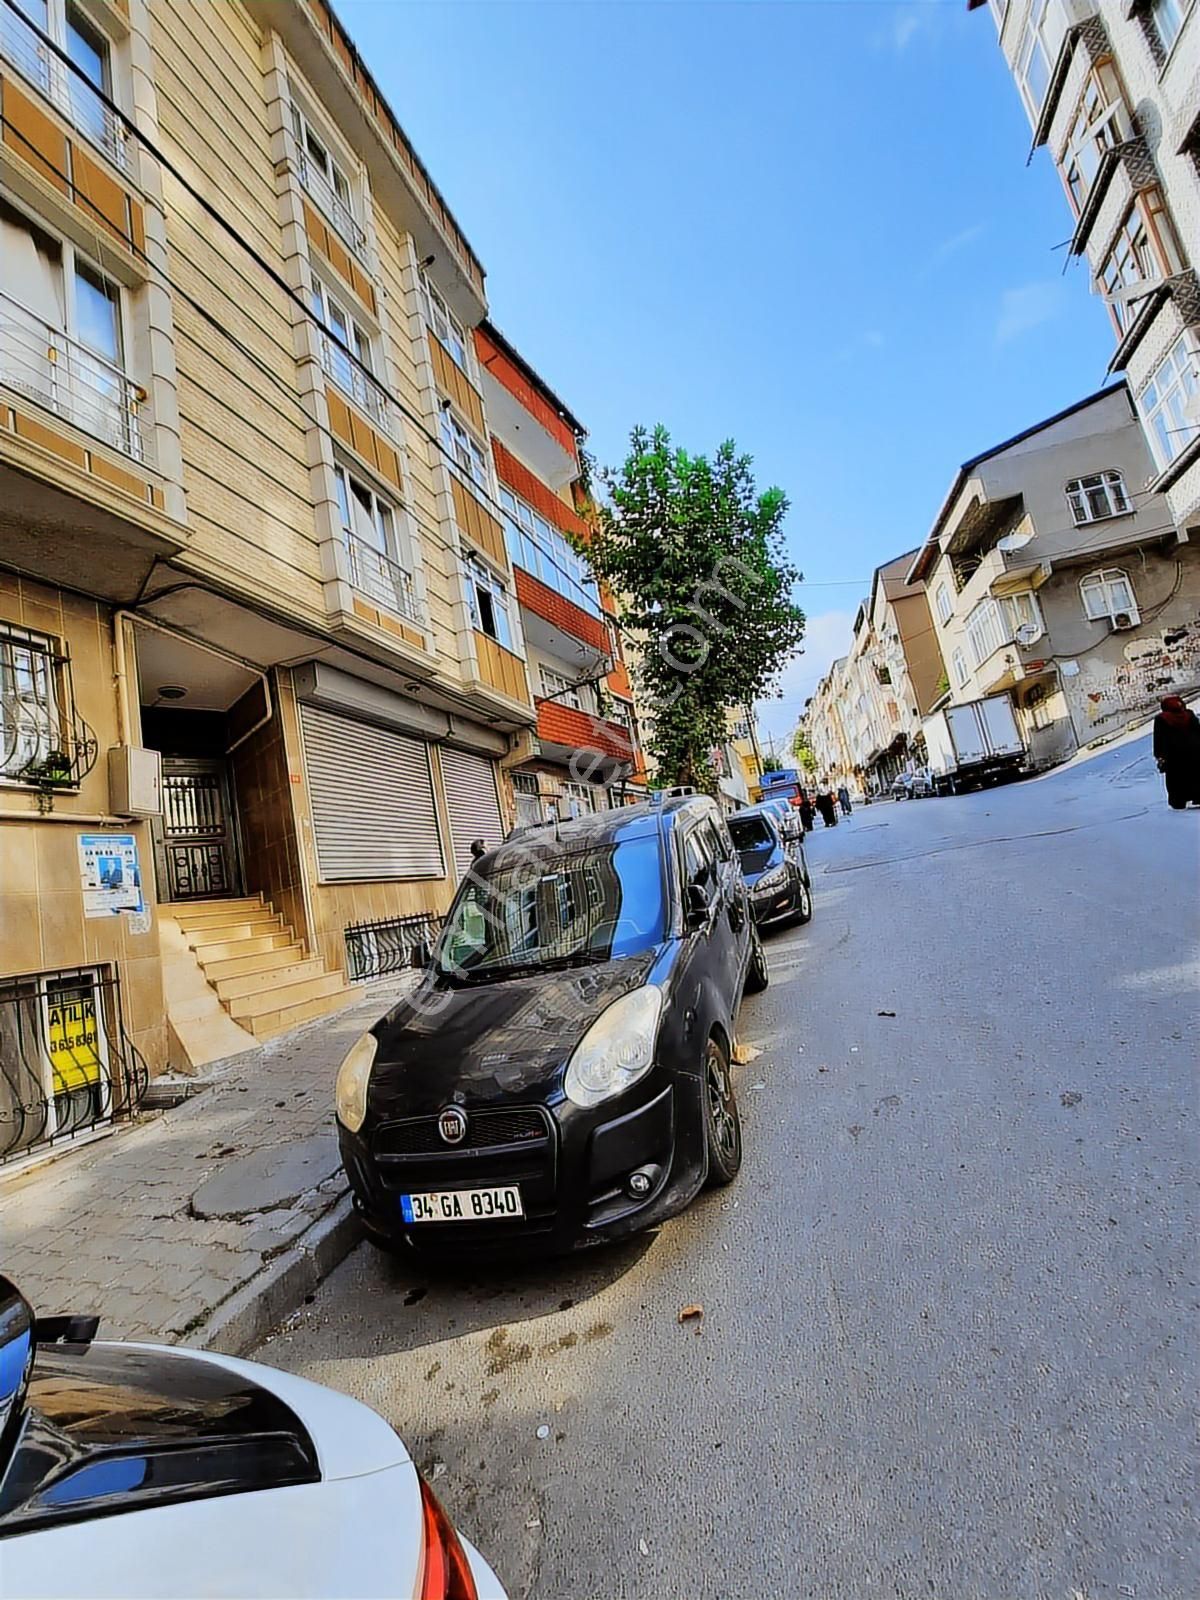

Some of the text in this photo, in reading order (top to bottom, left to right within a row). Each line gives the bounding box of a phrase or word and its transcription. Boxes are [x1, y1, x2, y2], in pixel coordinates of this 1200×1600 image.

[50, 1004, 95, 1026] ATILK
[413, 1190, 517, 1218] 34 GA 8340
